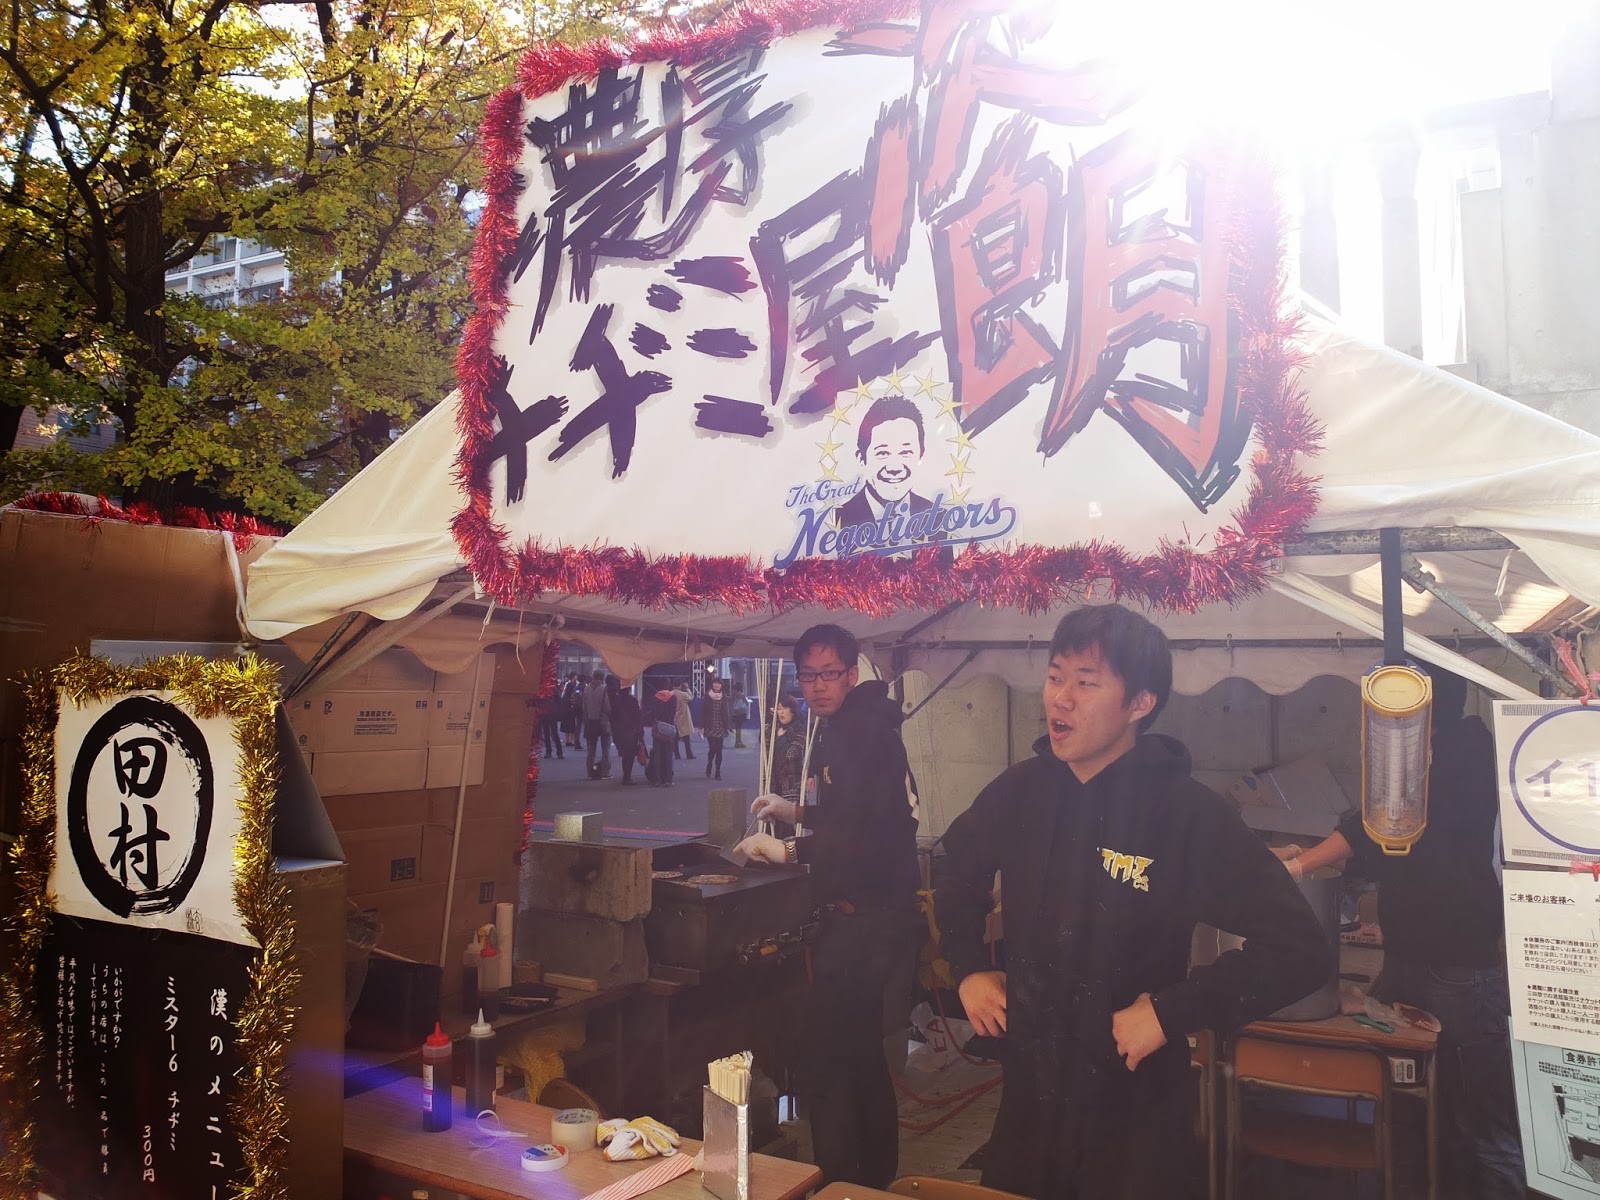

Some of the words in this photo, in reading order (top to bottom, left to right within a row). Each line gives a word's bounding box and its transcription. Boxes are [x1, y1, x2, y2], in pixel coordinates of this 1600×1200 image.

[773, 493, 1017, 570] Negotiators
[108, 736, 171, 891] 田村
[1509, 893, 1575, 905] ご来場のお客様へ
[167, 1090, 181, 1151] チヂミ
[142, 1125, 156, 1183] 300円
